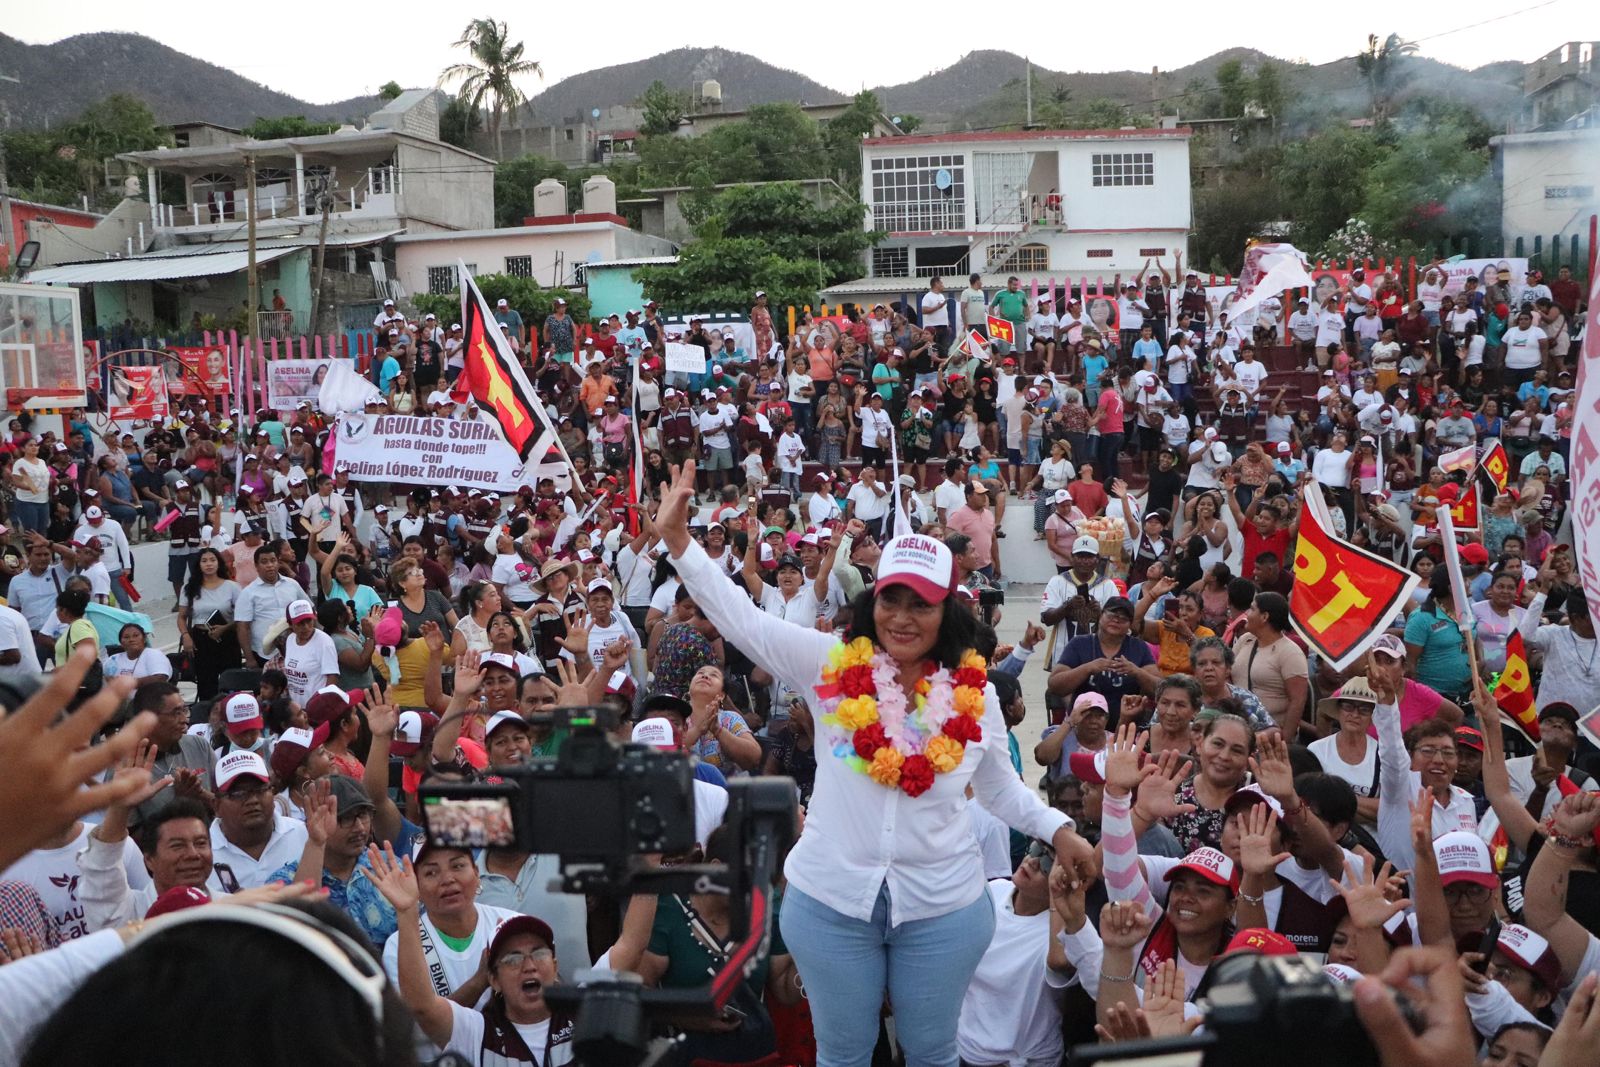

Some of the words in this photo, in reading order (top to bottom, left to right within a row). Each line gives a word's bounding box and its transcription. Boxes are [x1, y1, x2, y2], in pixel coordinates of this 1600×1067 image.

[989, 323, 1009, 340] PT
[274, 367, 312, 375] ABELINA
[448, 420, 500, 441] SURIA
[383, 438, 412, 450] hasta
[413, 438, 450, 453] donde
[450, 443, 487, 455] tope!!!
[421, 453, 443, 464] con
[385, 460, 424, 478] López
[427, 463, 499, 483] Rodríguez
[895, 537, 938, 556] ABELINA
[1293, 531, 1372, 634] PT
[221, 754, 256, 769] ABELINA
[1439, 845, 1478, 856] ABELINA
[1247, 936, 1265, 948] PT
[1286, 934, 1319, 943] morena
